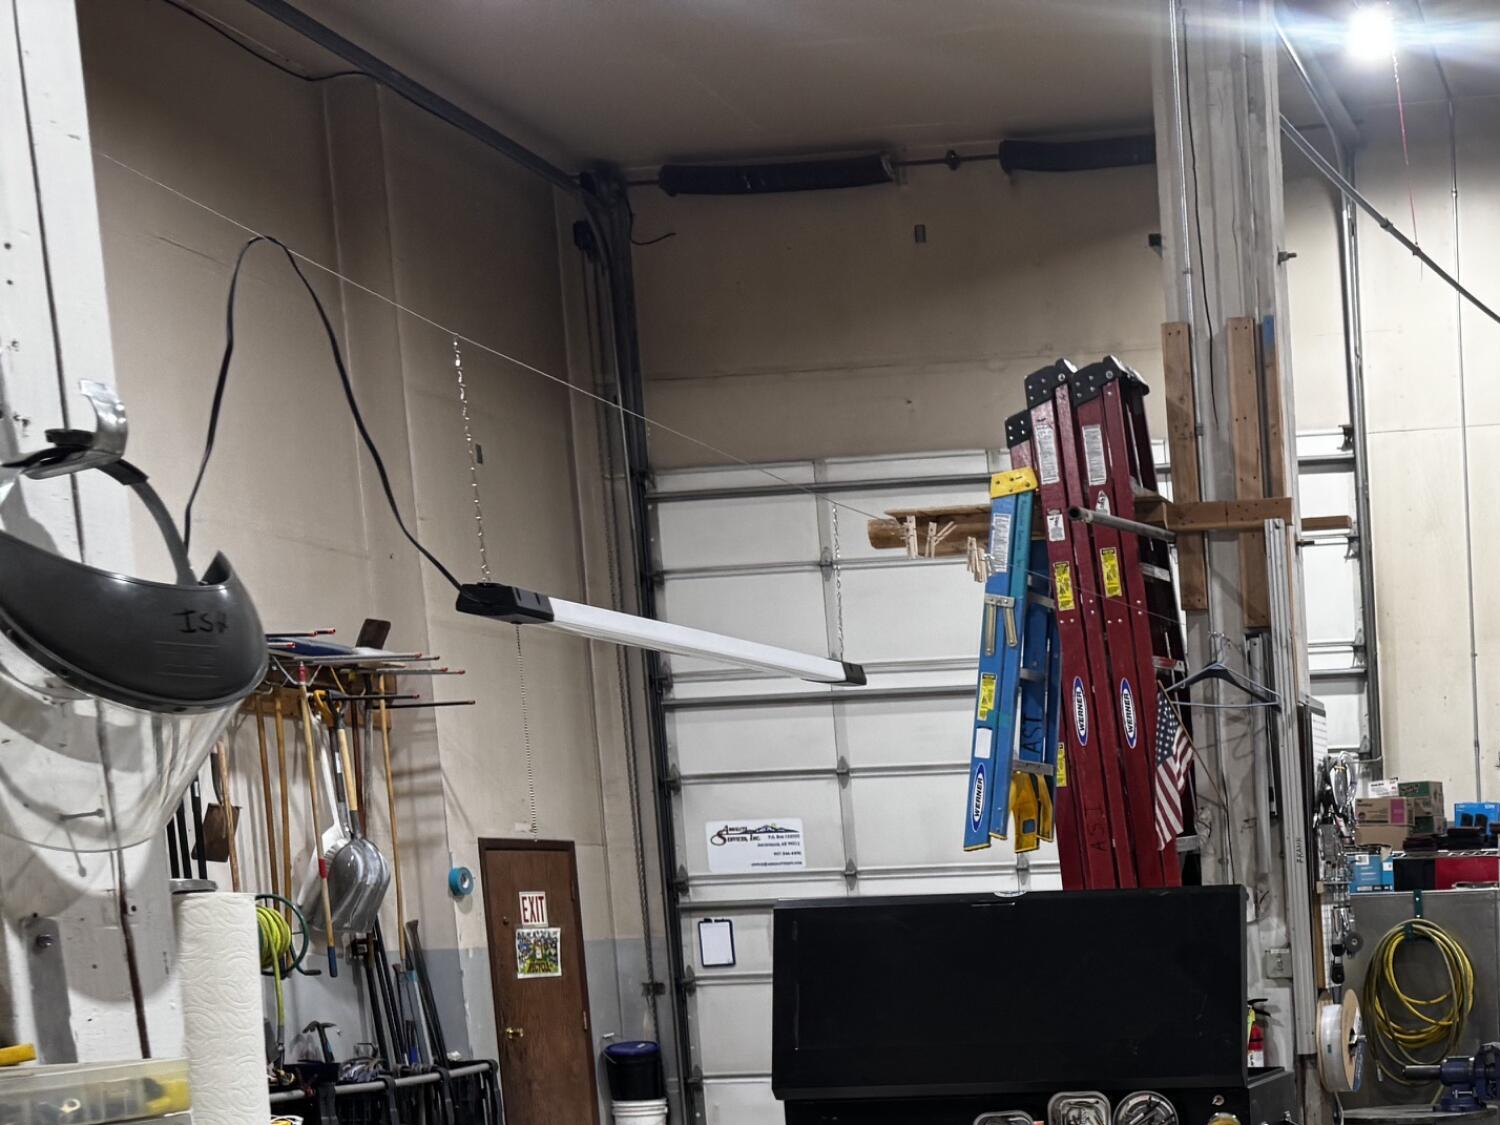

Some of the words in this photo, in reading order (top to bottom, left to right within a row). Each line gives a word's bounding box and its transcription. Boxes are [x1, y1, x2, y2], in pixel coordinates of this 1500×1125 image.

[1075, 691, 1085, 731] WERNER
[1123, 693, 1134, 733] WERNER
[973, 777, 983, 818] WERNER
[521, 896, 545, 923] EXIT
